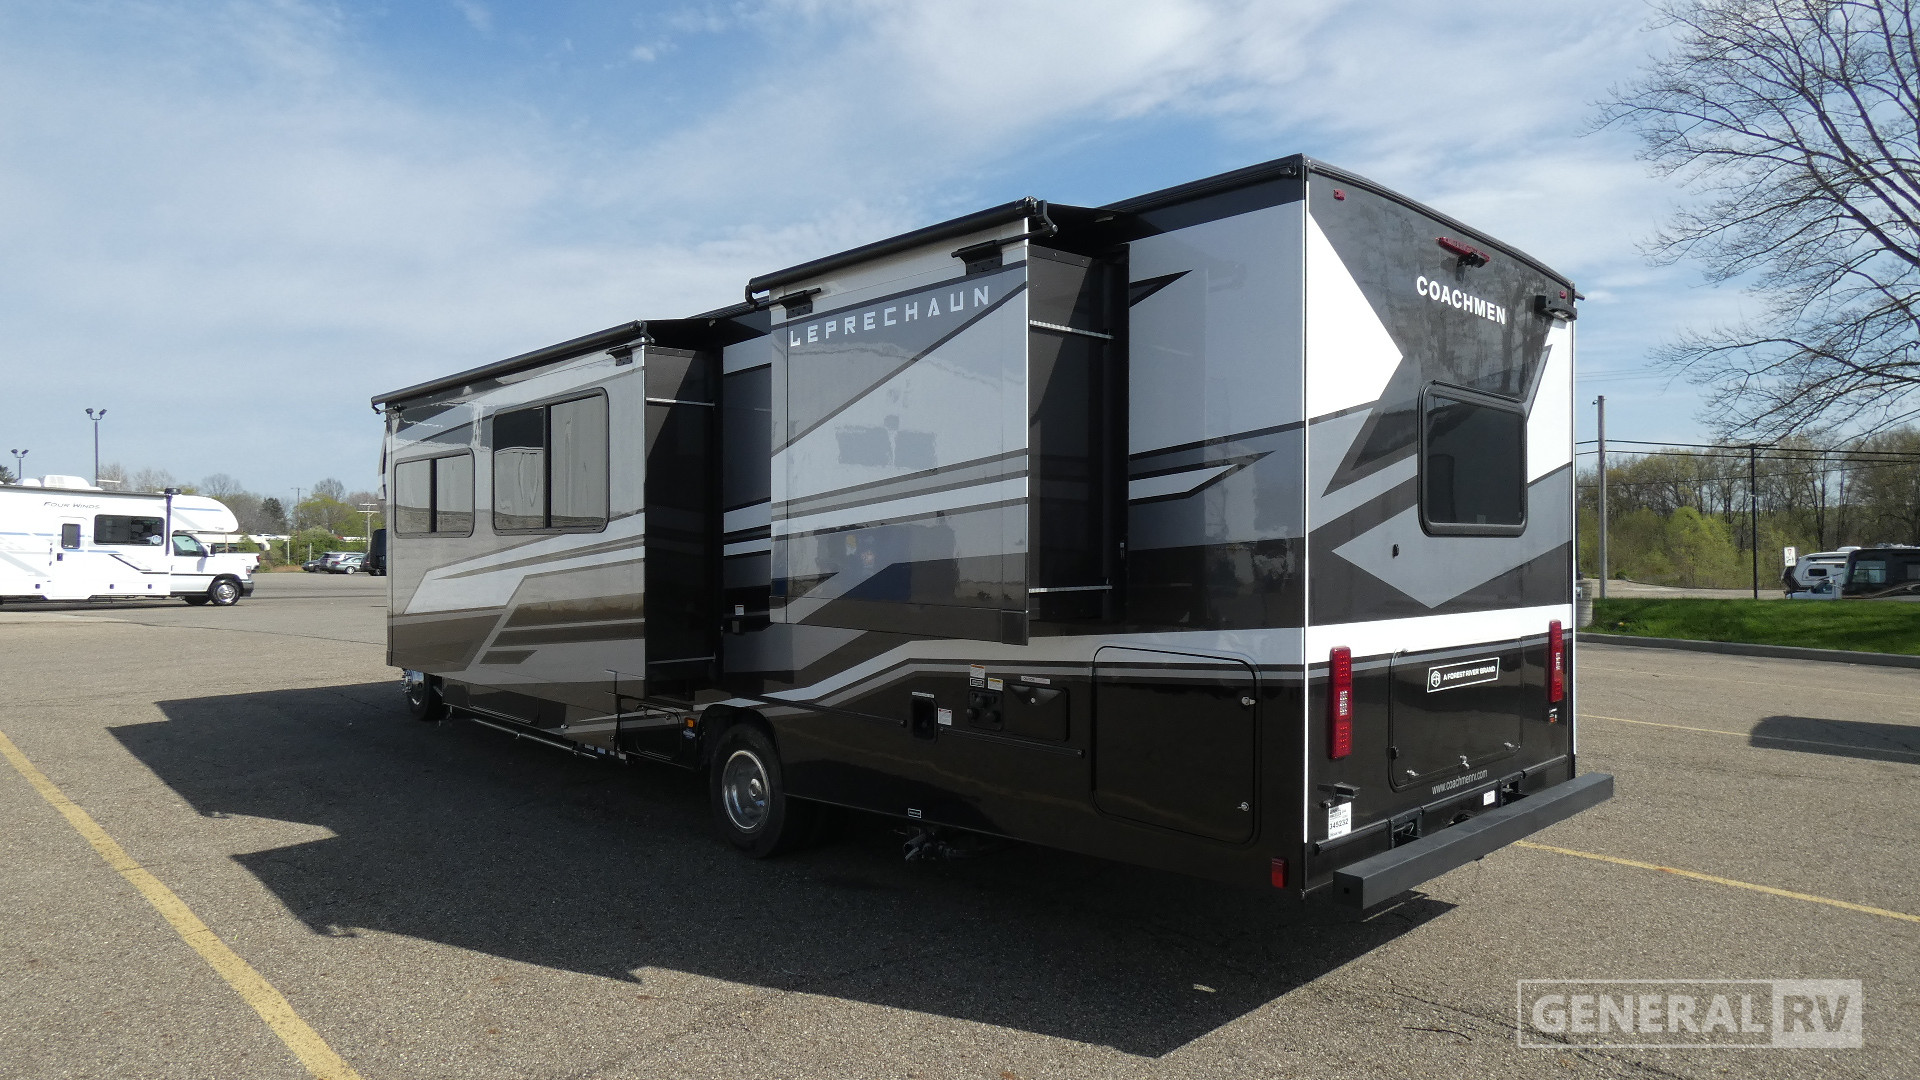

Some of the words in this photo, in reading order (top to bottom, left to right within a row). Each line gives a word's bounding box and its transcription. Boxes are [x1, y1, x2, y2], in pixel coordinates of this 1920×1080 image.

[789, 285, 989, 347] LEPRECHAUN
[1416, 275, 1506, 325] COACHMEN
[1447, 670, 1466, 680] FOREST
[1466, 668, 1479, 677] RIVER
[1479, 665, 1496, 674] BRAND
[1432, 769, 1488, 795] www.coachmenrv.com
